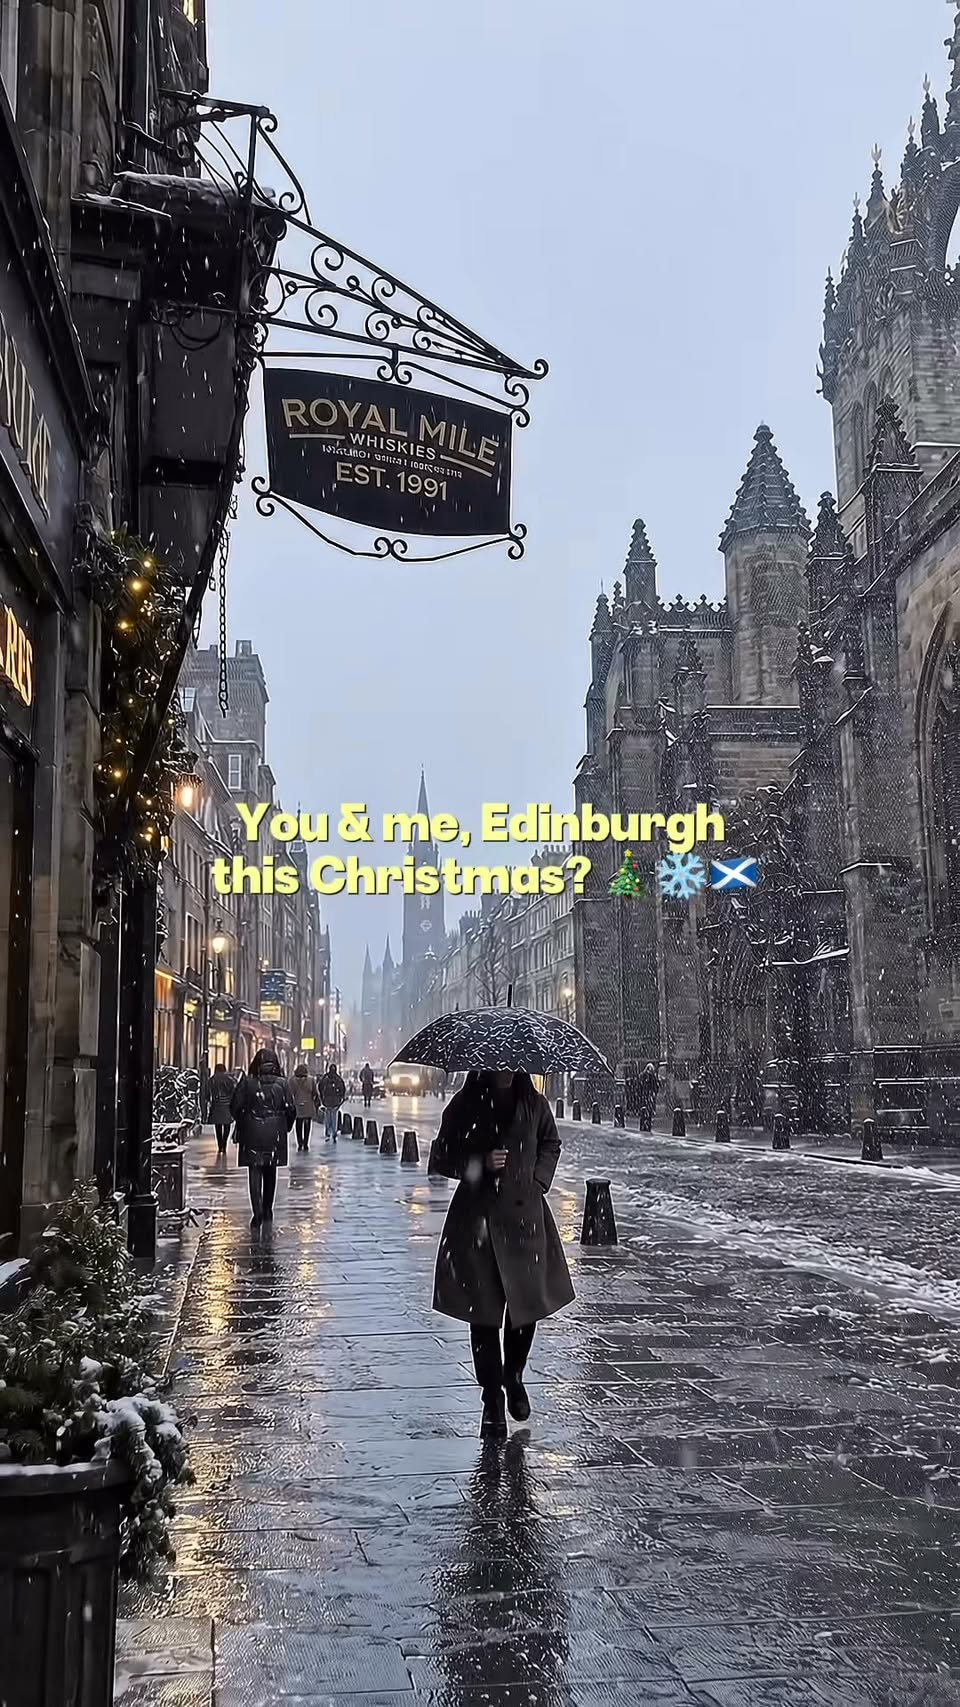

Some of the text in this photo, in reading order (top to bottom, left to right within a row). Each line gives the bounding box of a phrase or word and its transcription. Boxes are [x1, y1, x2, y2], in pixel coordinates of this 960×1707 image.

[281, 398, 408, 437] ROYAL
[418, 414, 500, 467] MILE
[350, 432, 436, 460] WHISKIES
[336, 461, 391, 489] EST.
[397, 471, 447, 501] 1991
[0, 600, 33, 707] RES
